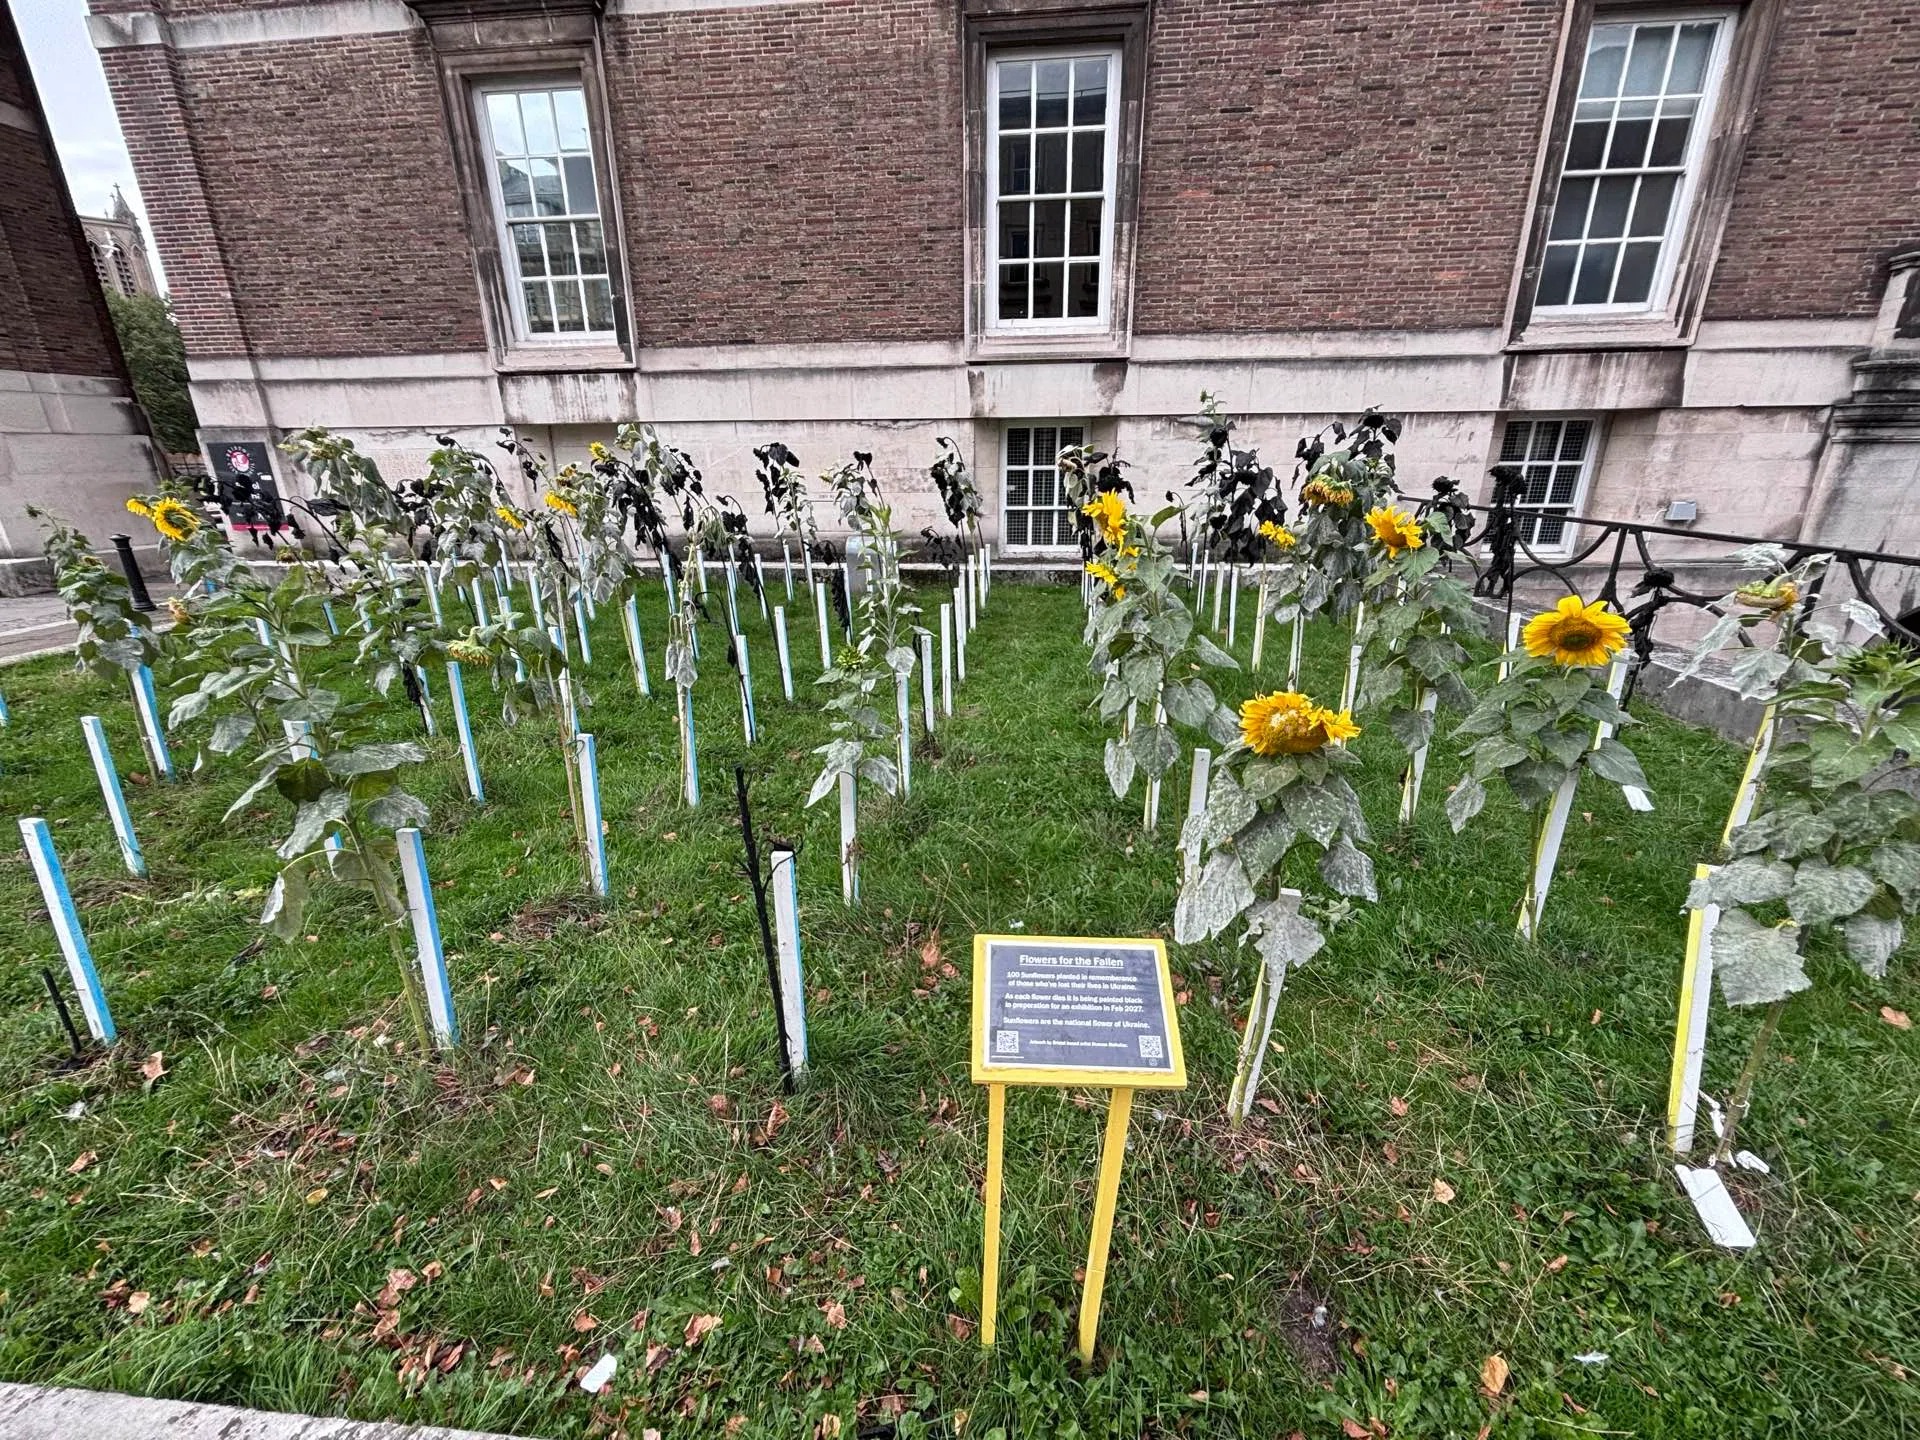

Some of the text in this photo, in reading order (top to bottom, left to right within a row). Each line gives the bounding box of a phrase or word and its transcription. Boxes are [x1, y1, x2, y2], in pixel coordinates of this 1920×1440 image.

[1019, 954, 1124, 967] Flowers for the Fallen
[1021, 971, 1056, 979] Sunflowers
[1056, 973, 1081, 981] planted
[1110, 983, 1137, 991] Ukraine.
[1031, 993, 1051, 1001] flower
[1080, 994, 1098, 1003] being
[1099, 996, 1124, 1004] painted
[1005, 1000, 1012, 1008] in
[1012, 1001, 1050, 1010] preparation
[1071, 1003, 1103, 1011] exhibition
[1111, 1004, 1124, 1012] Feb
[1124, 1005, 1144, 1013] 2027.
[1003, 1016, 1039, 1024] Sunflowers
[1064, 1018, 1092, 1026] national
[1092, 1019, 1113, 1027] flower
[1122, 1020, 1151, 1028] Ukraine.
